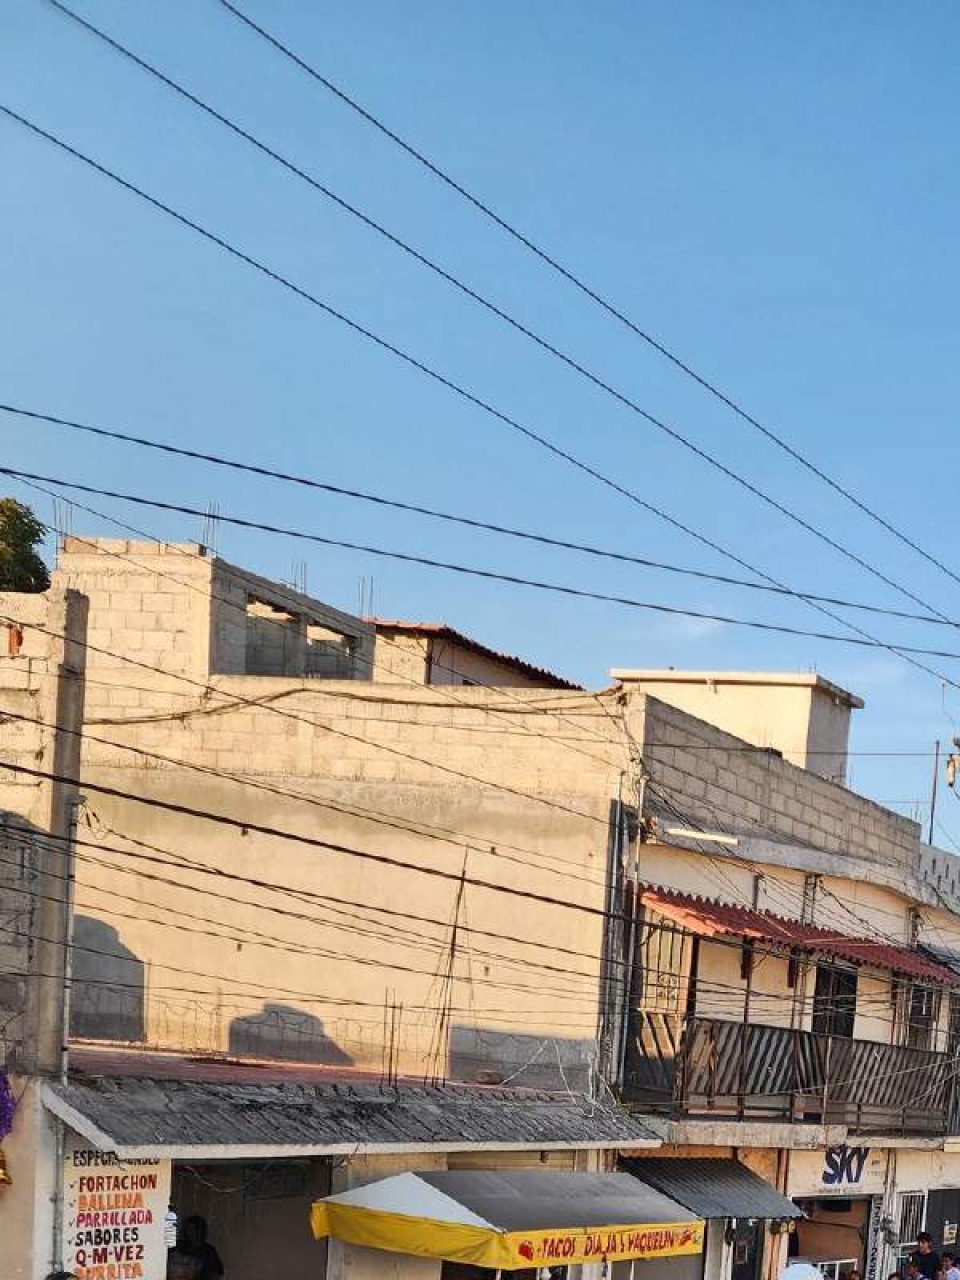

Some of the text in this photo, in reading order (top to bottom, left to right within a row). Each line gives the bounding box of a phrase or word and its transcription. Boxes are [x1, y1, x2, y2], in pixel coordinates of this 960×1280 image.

[822, 1144, 871, 1184] SKY
[79, 1174, 157, 1192] FORTACHON
[77, 1192, 144, 1211] BALLENA
[76, 1210, 153, 1228] PARRILLADA
[75, 1227, 139, 1247] SABORES
[541, 1237, 576, 1258] TACOS
